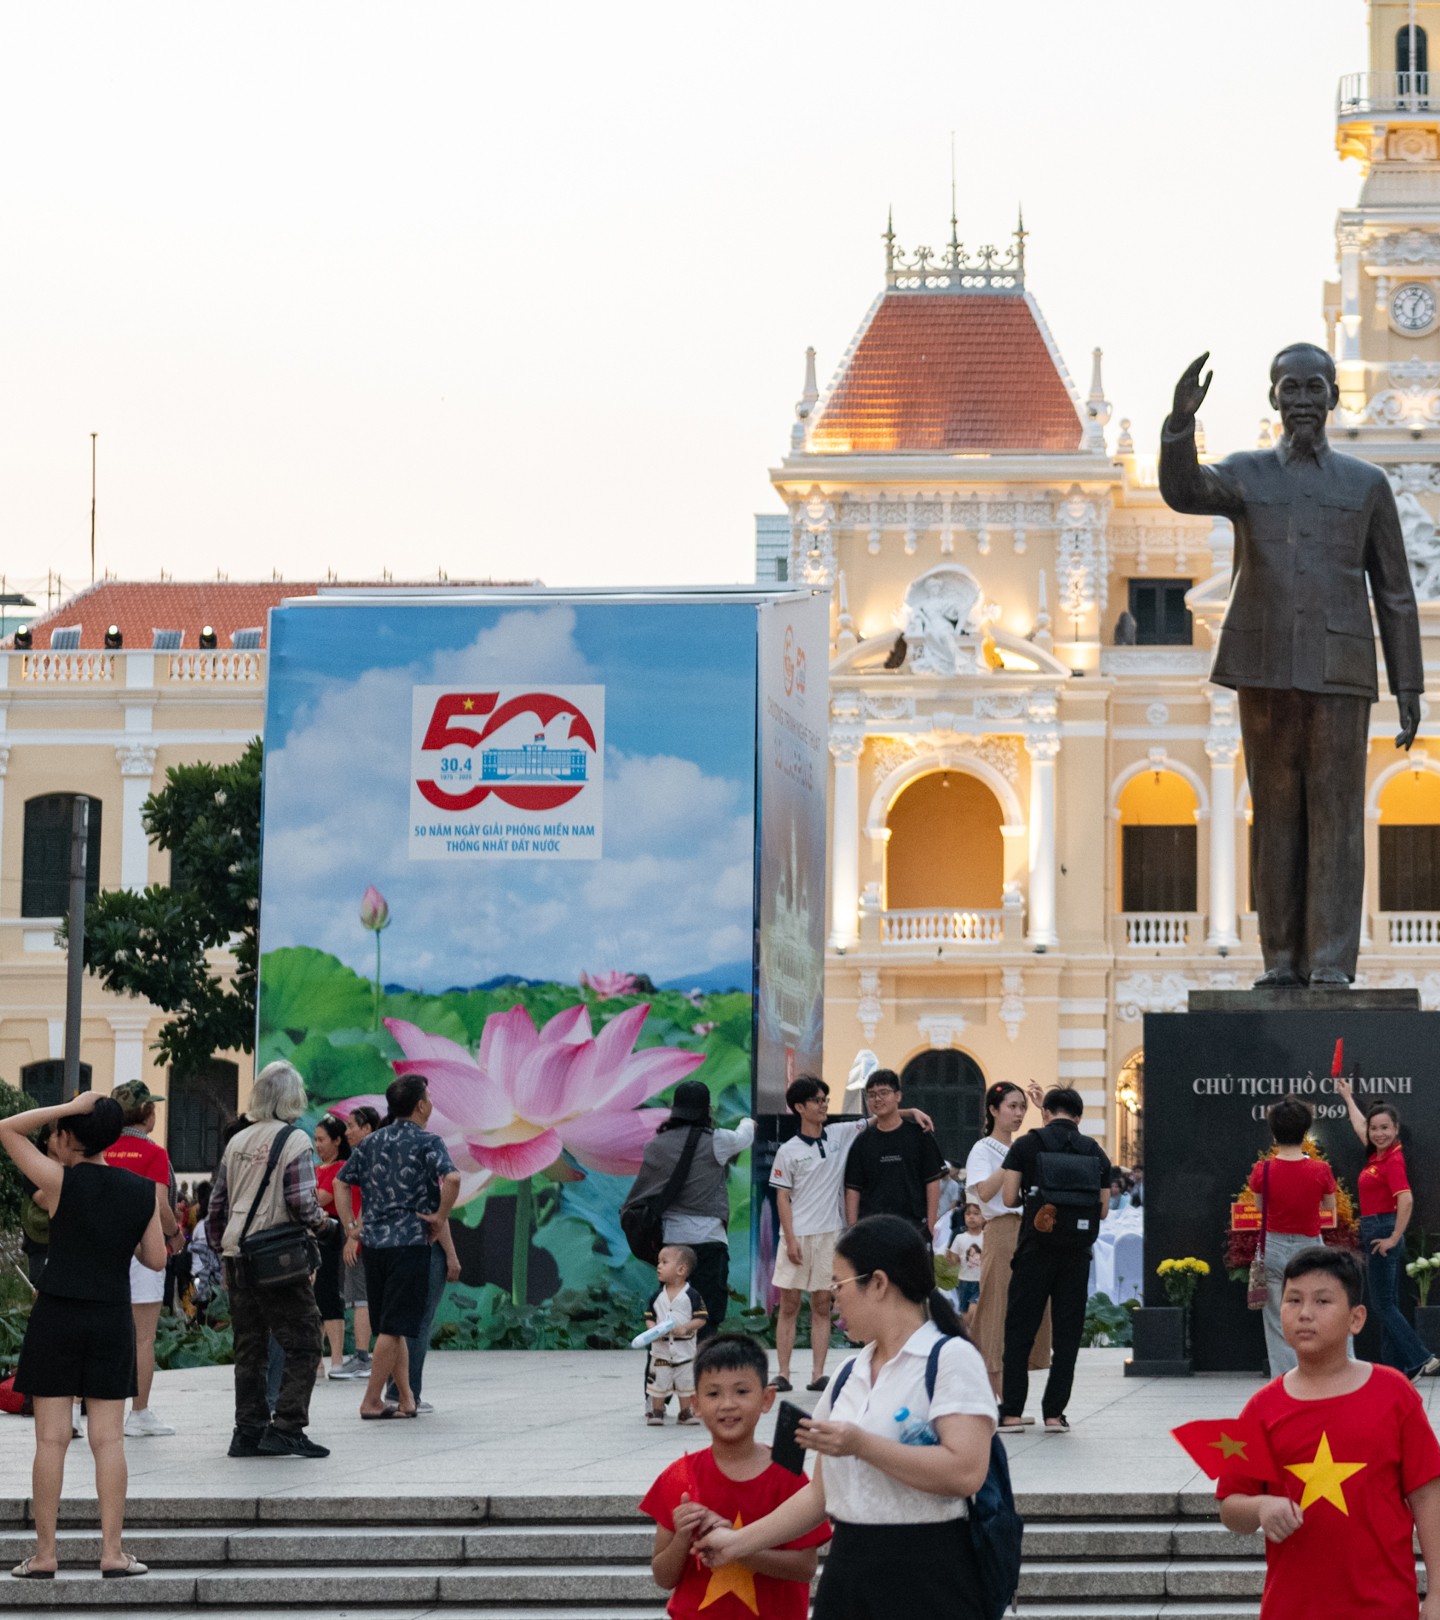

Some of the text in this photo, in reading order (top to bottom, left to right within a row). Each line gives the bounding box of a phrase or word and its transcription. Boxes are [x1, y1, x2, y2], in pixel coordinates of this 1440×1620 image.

[441, 757, 472, 772] 30.4
[414, 826, 427, 837] 50
[429, 823, 451, 837] NĂM
[454, 822, 480, 836] NGÀY
[482, 821, 503, 836] GIẢI
[505, 822, 541, 836] PHÓNG
[572, 825, 595, 836] NAM
[532, 837, 560, 851] NƯỚC
[1192, 1074, 1234, 1095] CHỦ
[1237, 1077, 1284, 1097] TỊCH
[1288, 1071, 1316, 1095] HỒ
[1359, 1077, 1412, 1095] MINH
